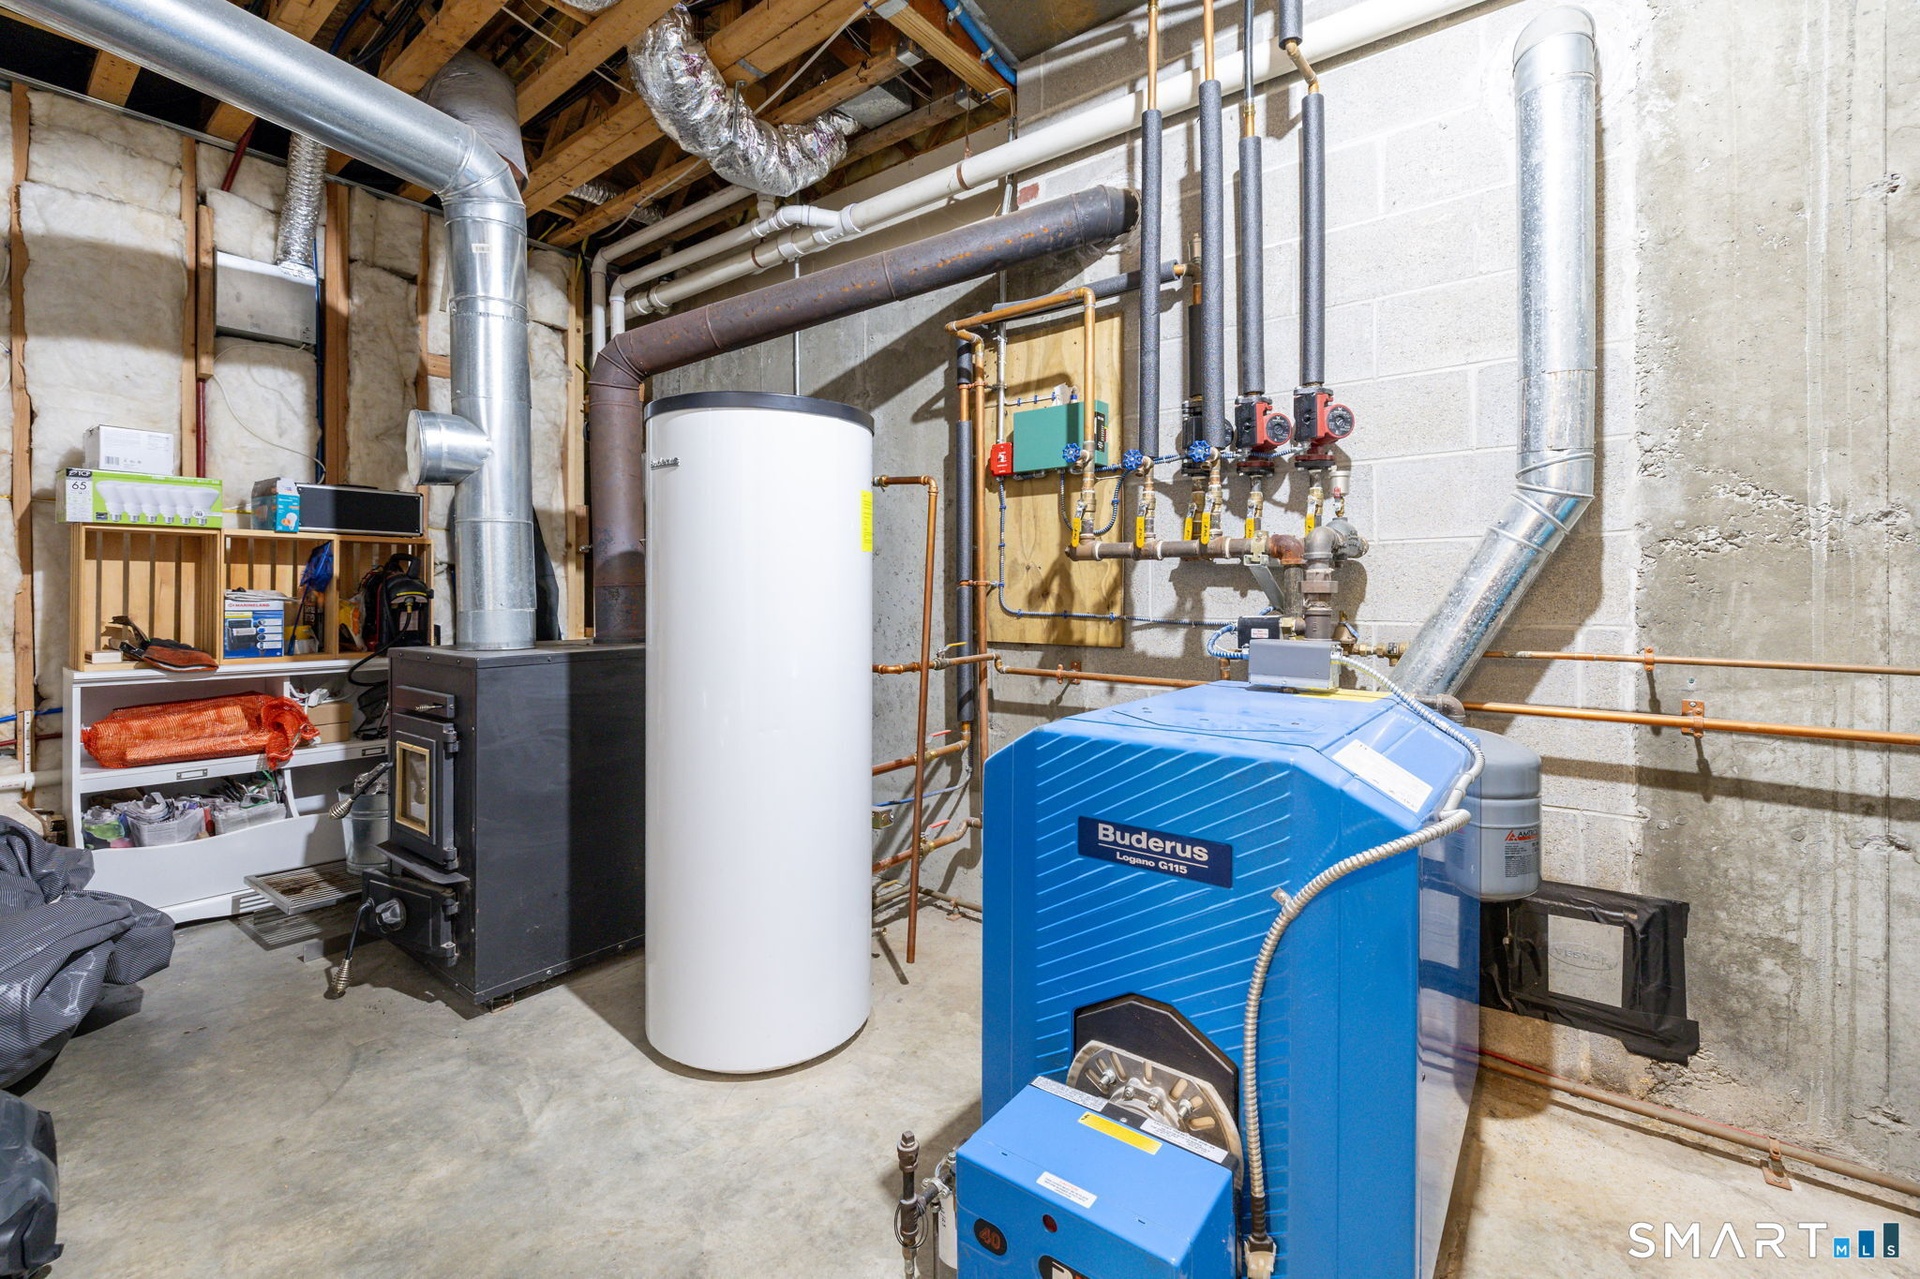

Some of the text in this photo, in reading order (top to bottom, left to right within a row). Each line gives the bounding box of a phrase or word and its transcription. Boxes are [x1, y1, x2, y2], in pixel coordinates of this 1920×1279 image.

[71, 481, 87, 490] 65
[1097, 823, 1209, 861] Buderus
[1116, 851, 1188, 875] Logano G115
[978, 1227, 1002, 1251] 40
